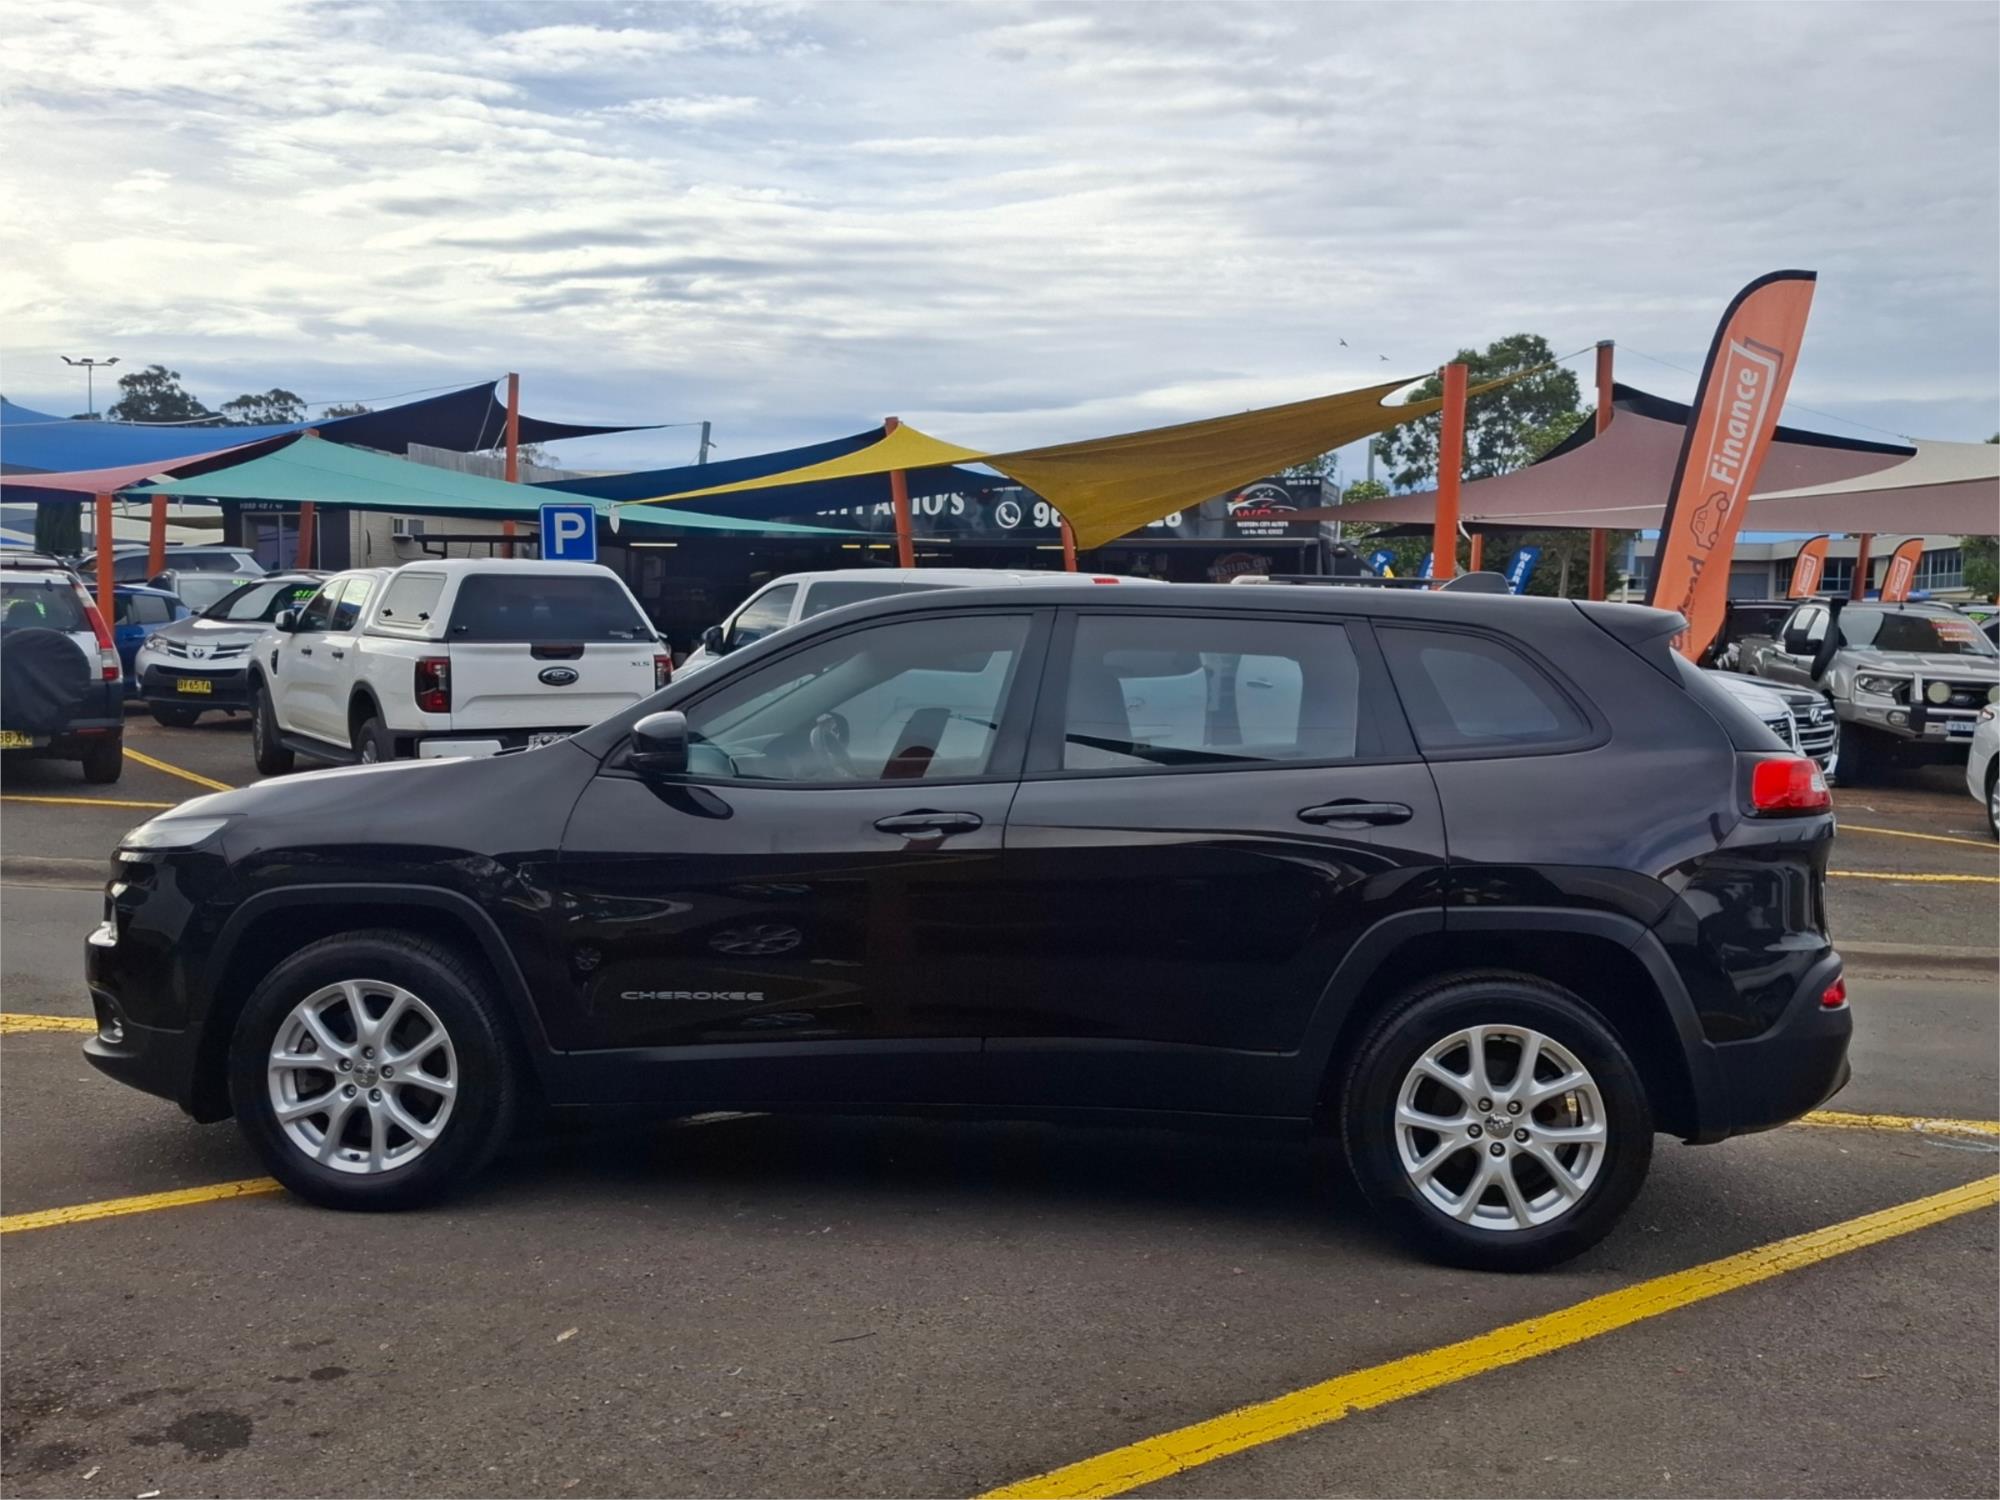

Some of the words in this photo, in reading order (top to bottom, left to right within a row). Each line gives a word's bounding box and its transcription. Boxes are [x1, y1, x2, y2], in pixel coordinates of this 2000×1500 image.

[1710, 367, 1759, 485] Finance
[554, 512, 586, 554] P
[620, 991, 764, 1001] CHEROKEE
